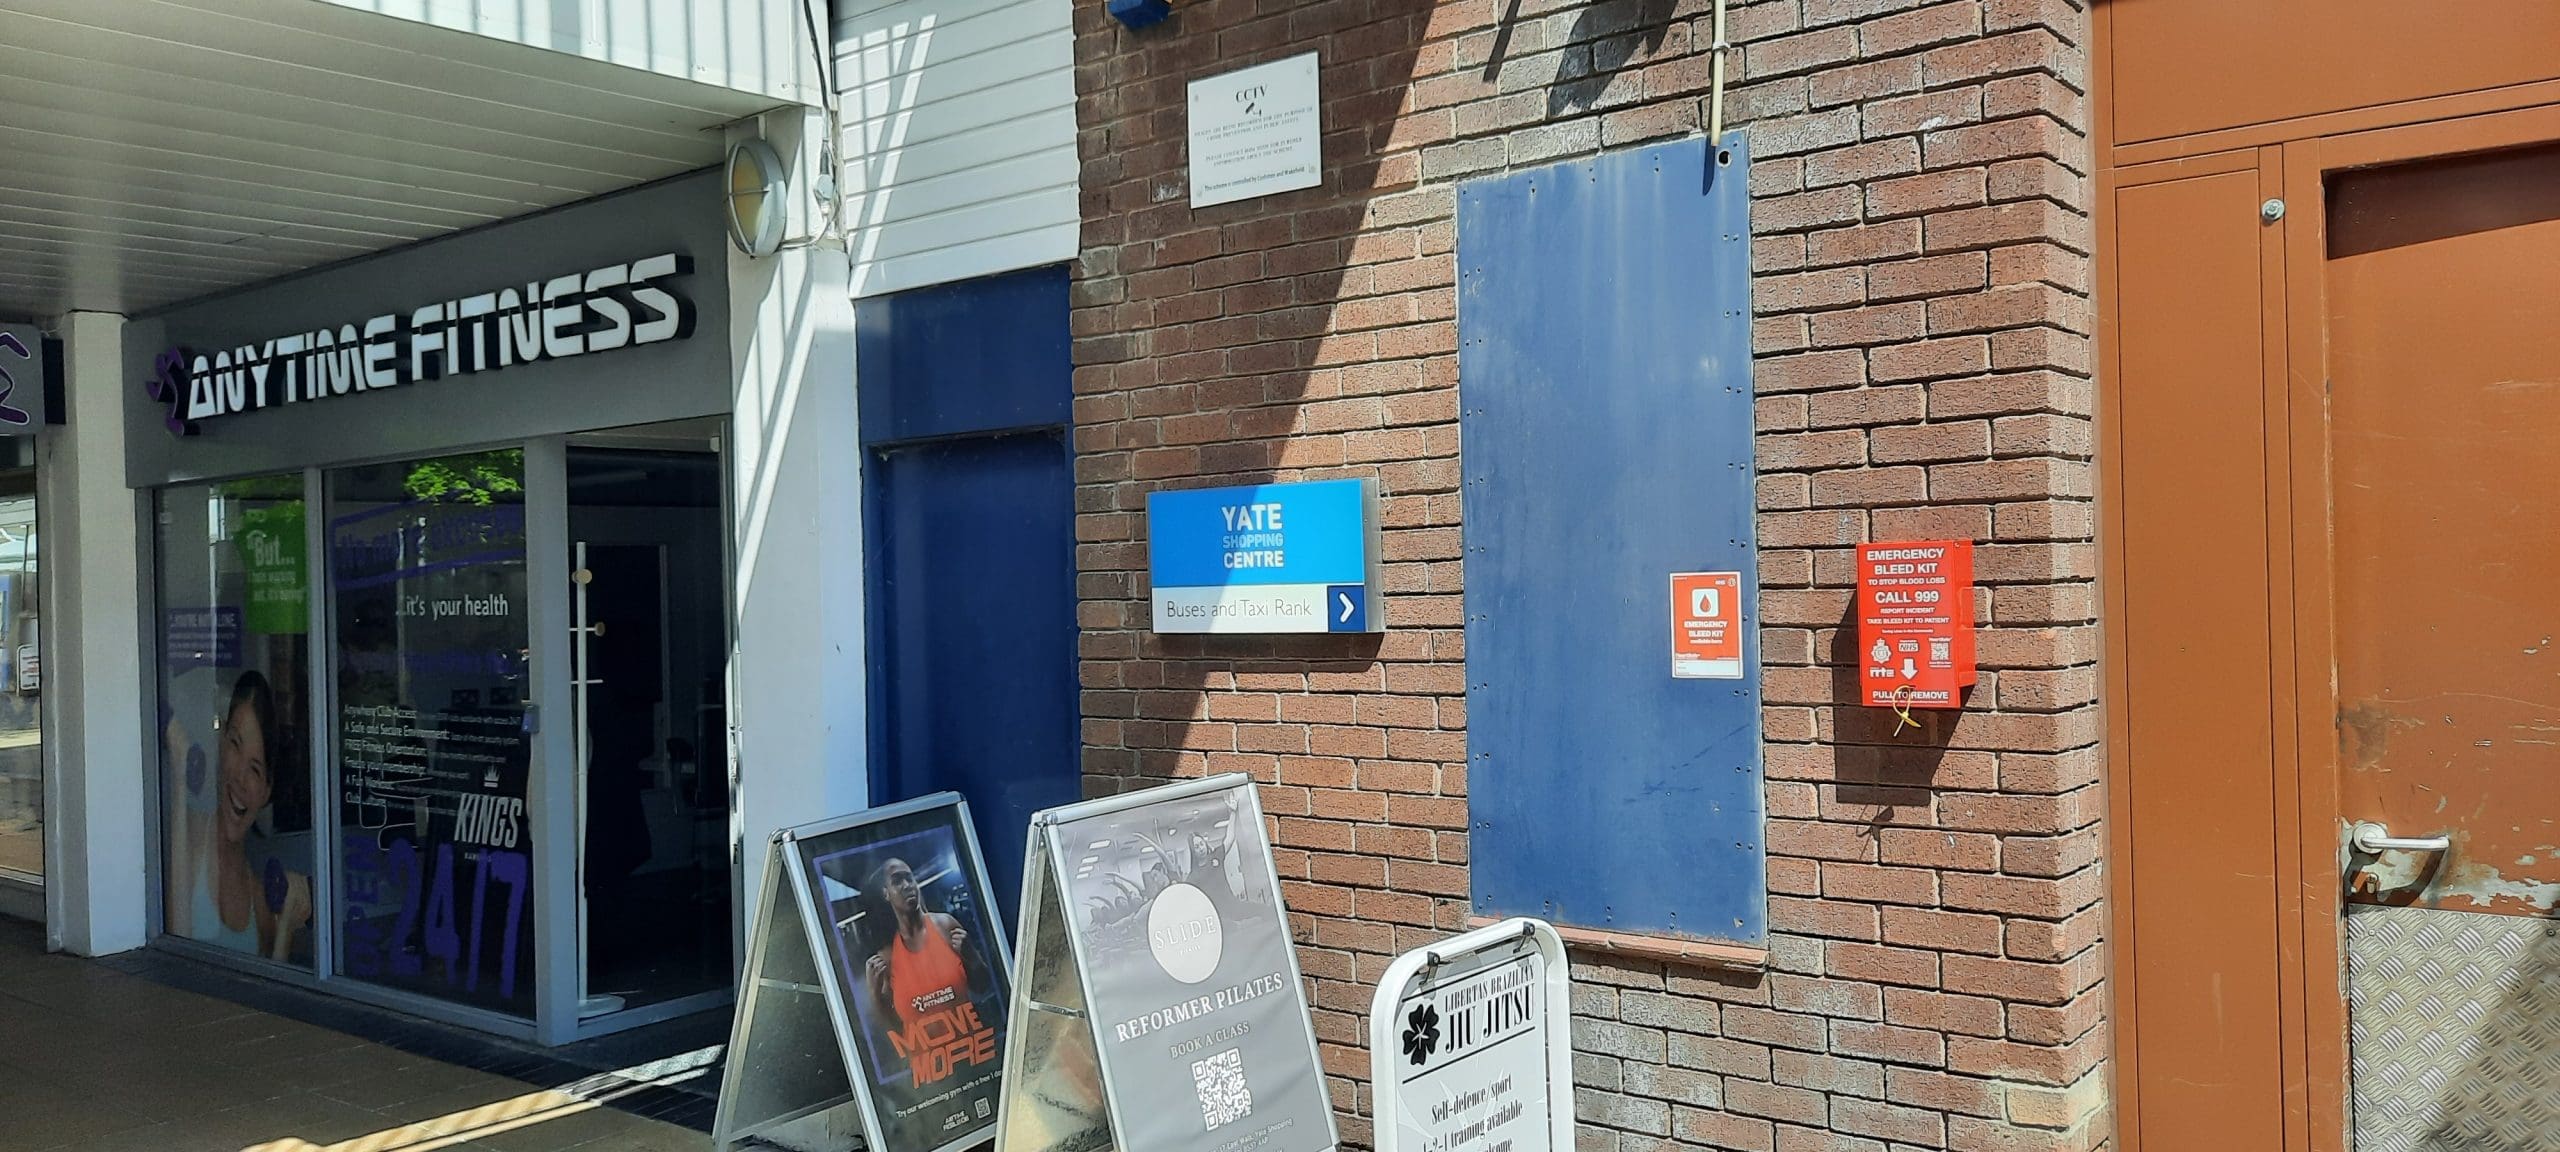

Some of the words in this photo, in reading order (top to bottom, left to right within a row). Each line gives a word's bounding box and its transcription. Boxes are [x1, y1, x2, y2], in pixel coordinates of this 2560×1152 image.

[1235, 84, 1267, 103] CCTV
[187, 314, 398, 420] ANYTIME
[411, 253, 684, 383] FITNESS
[1221, 503, 1283, 532] YATE
[1222, 532, 1284, 549] SHOPPING
[1866, 548, 1945, 561] EMERGENCY
[1223, 550, 1284, 569] CENTRE
[1874, 563, 1915, 575] BLEED
[1917, 562, 1938, 573] KIT
[1899, 577, 1925, 585] BLOOD
[1926, 576, 1946, 584] LOSS
[431, 600, 462, 622] your
[464, 593, 509, 617] health
[1167, 600, 1206, 618] Buses
[1211, 599, 1237, 617] and
[1240, 599, 1269, 617] Taxi
[1275, 598, 1313, 616] Rank
[1875, 591, 1912, 604] CALL
[1914, 590, 1939, 602] 999
[1900, 643, 1918, 651] NHS
[1872, 691, 1894, 699] PULL
[1897, 691, 1908, 699] TO
[1911, 691, 1949, 699] REMOVE
[351, 721, 365, 733] Safe
[453, 792, 522, 849] KINGS
[388, 836, 528, 999] 24/7
[1154, 915, 1216, 950] SLIDE
[922, 986, 953, 1002] ANYTIME
[922, 993, 955, 1009] FITNESS
[1445, 980, 1488, 1013] LIBERTAS
[1490, 964, 1534, 996] BRAZILIAN
[1115, 996, 1214, 1043] REFORMER
[1215, 972, 1284, 1011] PILATES
[1445, 1006, 1477, 1053] JIU
[1483, 983, 1535, 1038] JITSU
[887, 1002, 983, 1058] MOVE
[1170, 1036, 1203, 1059] BOOK
[1204, 1034, 1214, 1047] A
[1215, 1021, 1250, 1043] CLASS
[911, 1027, 995, 1089] MORE
[896, 1110, 907, 1118] Try
[907, 1106, 918, 1114] our
[918, 1092, 949, 1109] welcoming
[949, 1087, 962, 1099] gym
[962, 1081, 975, 1091] with
[1431, 1072, 1513, 1125] Self-defence/sport
[1450, 1118, 1485, 1149] training
[1486, 1099, 1523, 1132] available
